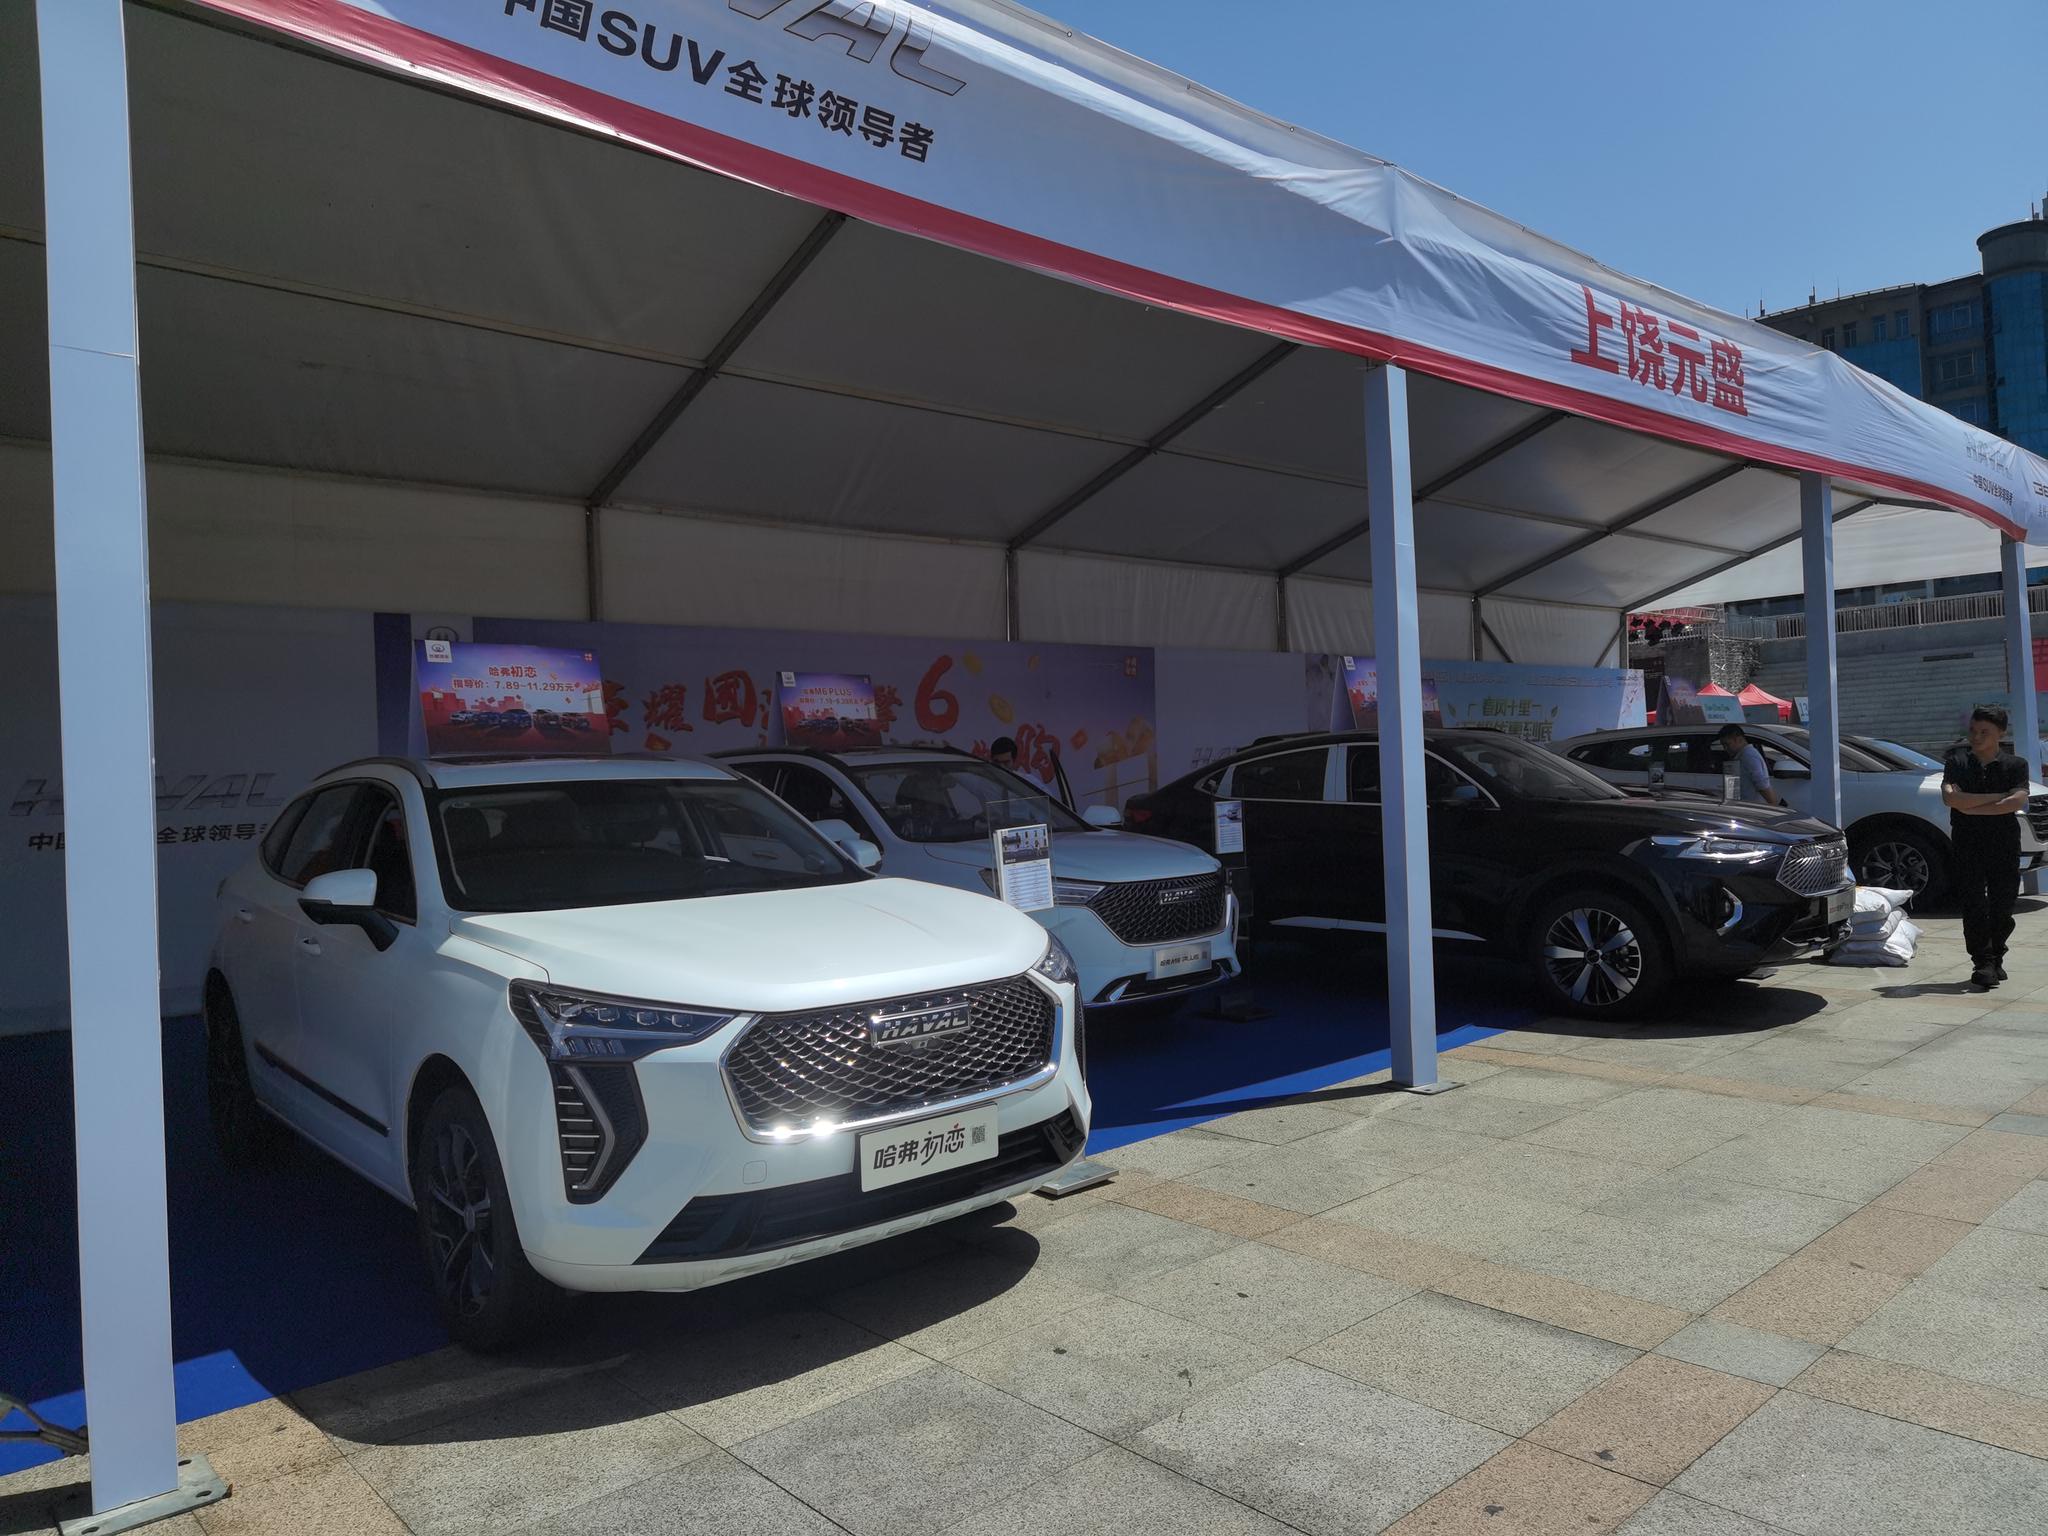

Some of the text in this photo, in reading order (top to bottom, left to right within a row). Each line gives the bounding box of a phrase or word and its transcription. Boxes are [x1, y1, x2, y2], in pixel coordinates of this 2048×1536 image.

[1570, 284, 1748, 416] 上饶元盛
[488, 665, 537, 678] 哈弗初恋
[881, 1009, 967, 1039] HAVAL
[873, 1122, 966, 1170] 哈弗初恋
